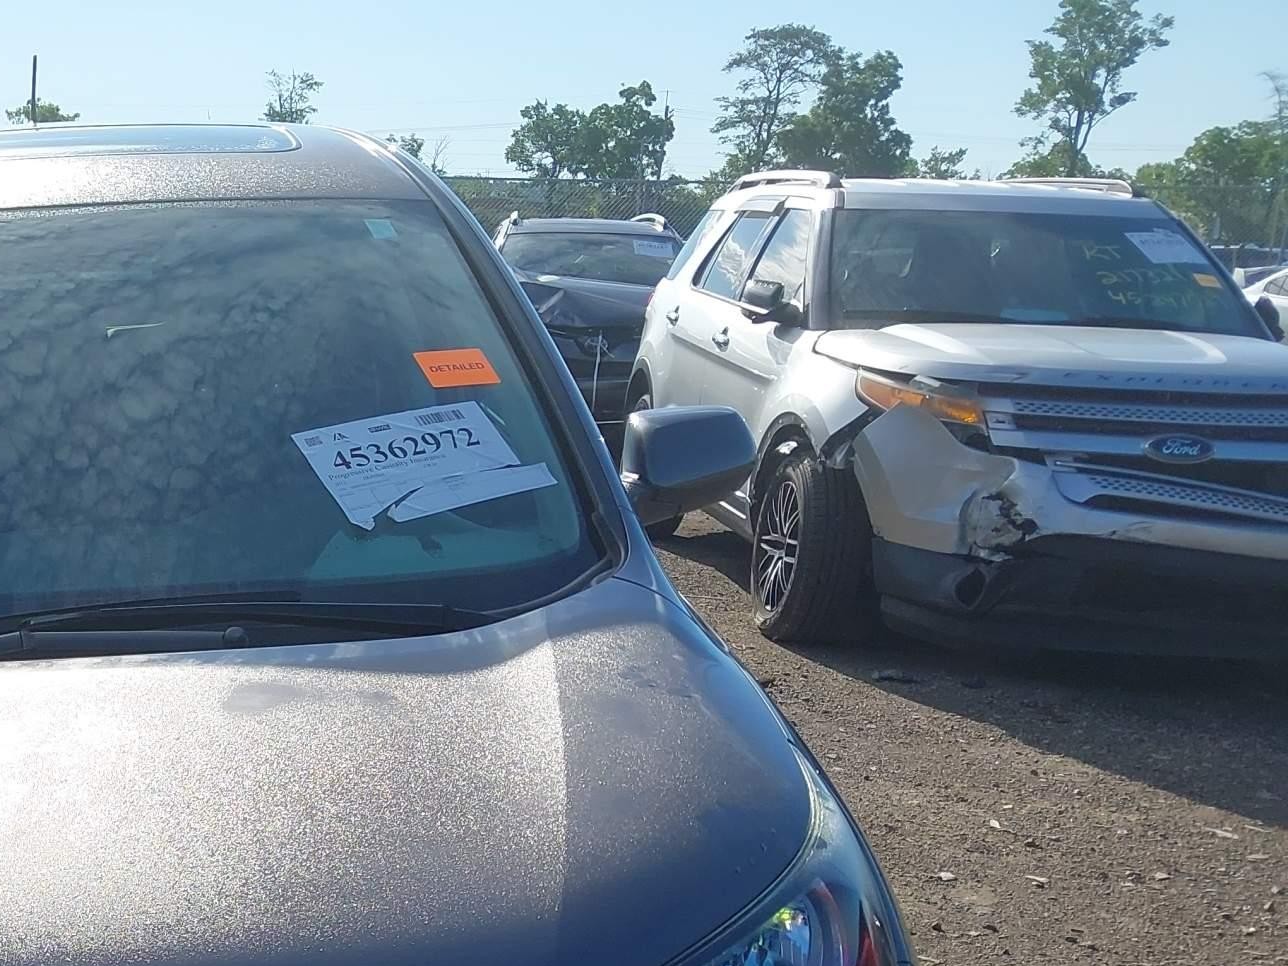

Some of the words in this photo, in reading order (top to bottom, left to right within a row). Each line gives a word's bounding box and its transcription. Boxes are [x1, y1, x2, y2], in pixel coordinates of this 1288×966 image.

[429, 362, 485, 373] DETAILED
[333, 427, 480, 470] 45362972
[1162, 438, 1201, 455] Ford
